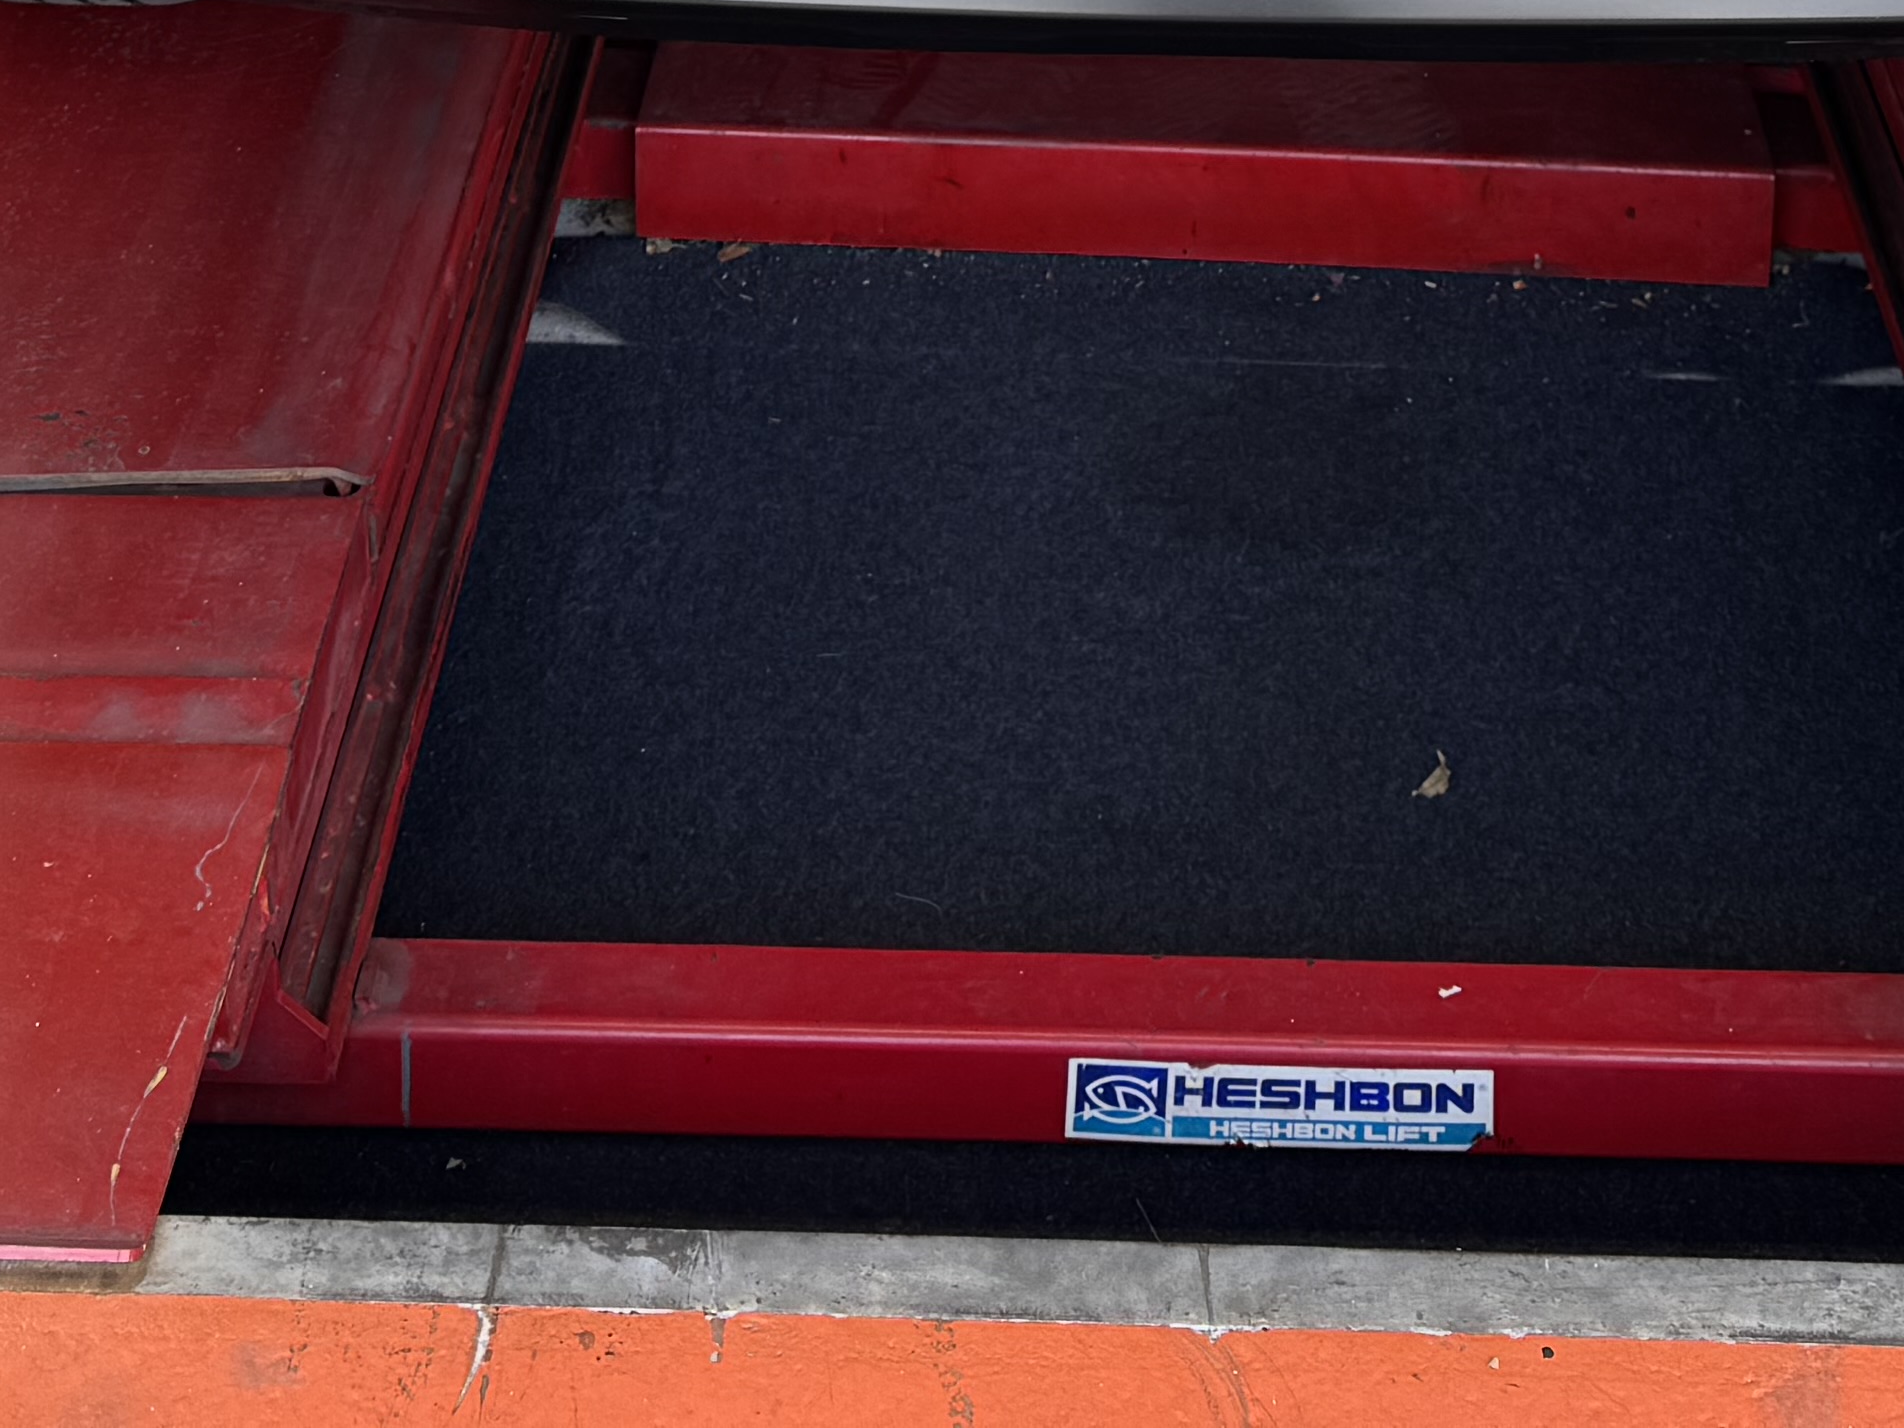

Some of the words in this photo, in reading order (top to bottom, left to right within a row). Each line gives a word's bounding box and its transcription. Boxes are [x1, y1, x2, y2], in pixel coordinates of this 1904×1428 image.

[1174, 1075, 1475, 1114] HESHBON
[1209, 1119, 1356, 1143] HESHBON
[1363, 1123, 1446, 1143] LIFT
